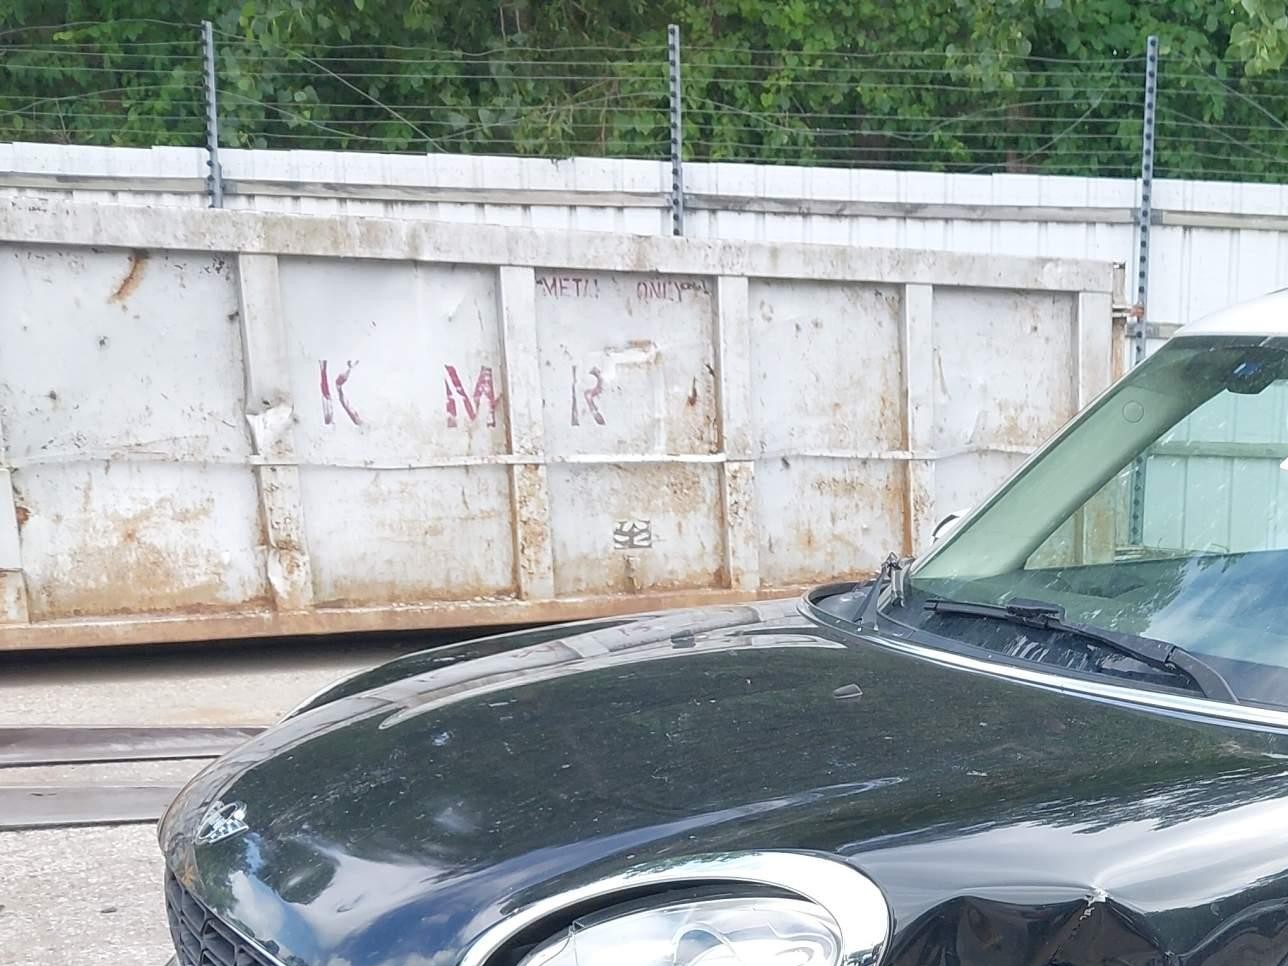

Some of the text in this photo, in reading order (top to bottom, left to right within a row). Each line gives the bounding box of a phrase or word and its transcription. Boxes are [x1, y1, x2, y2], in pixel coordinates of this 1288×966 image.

[318, 359, 606, 428] K M R
